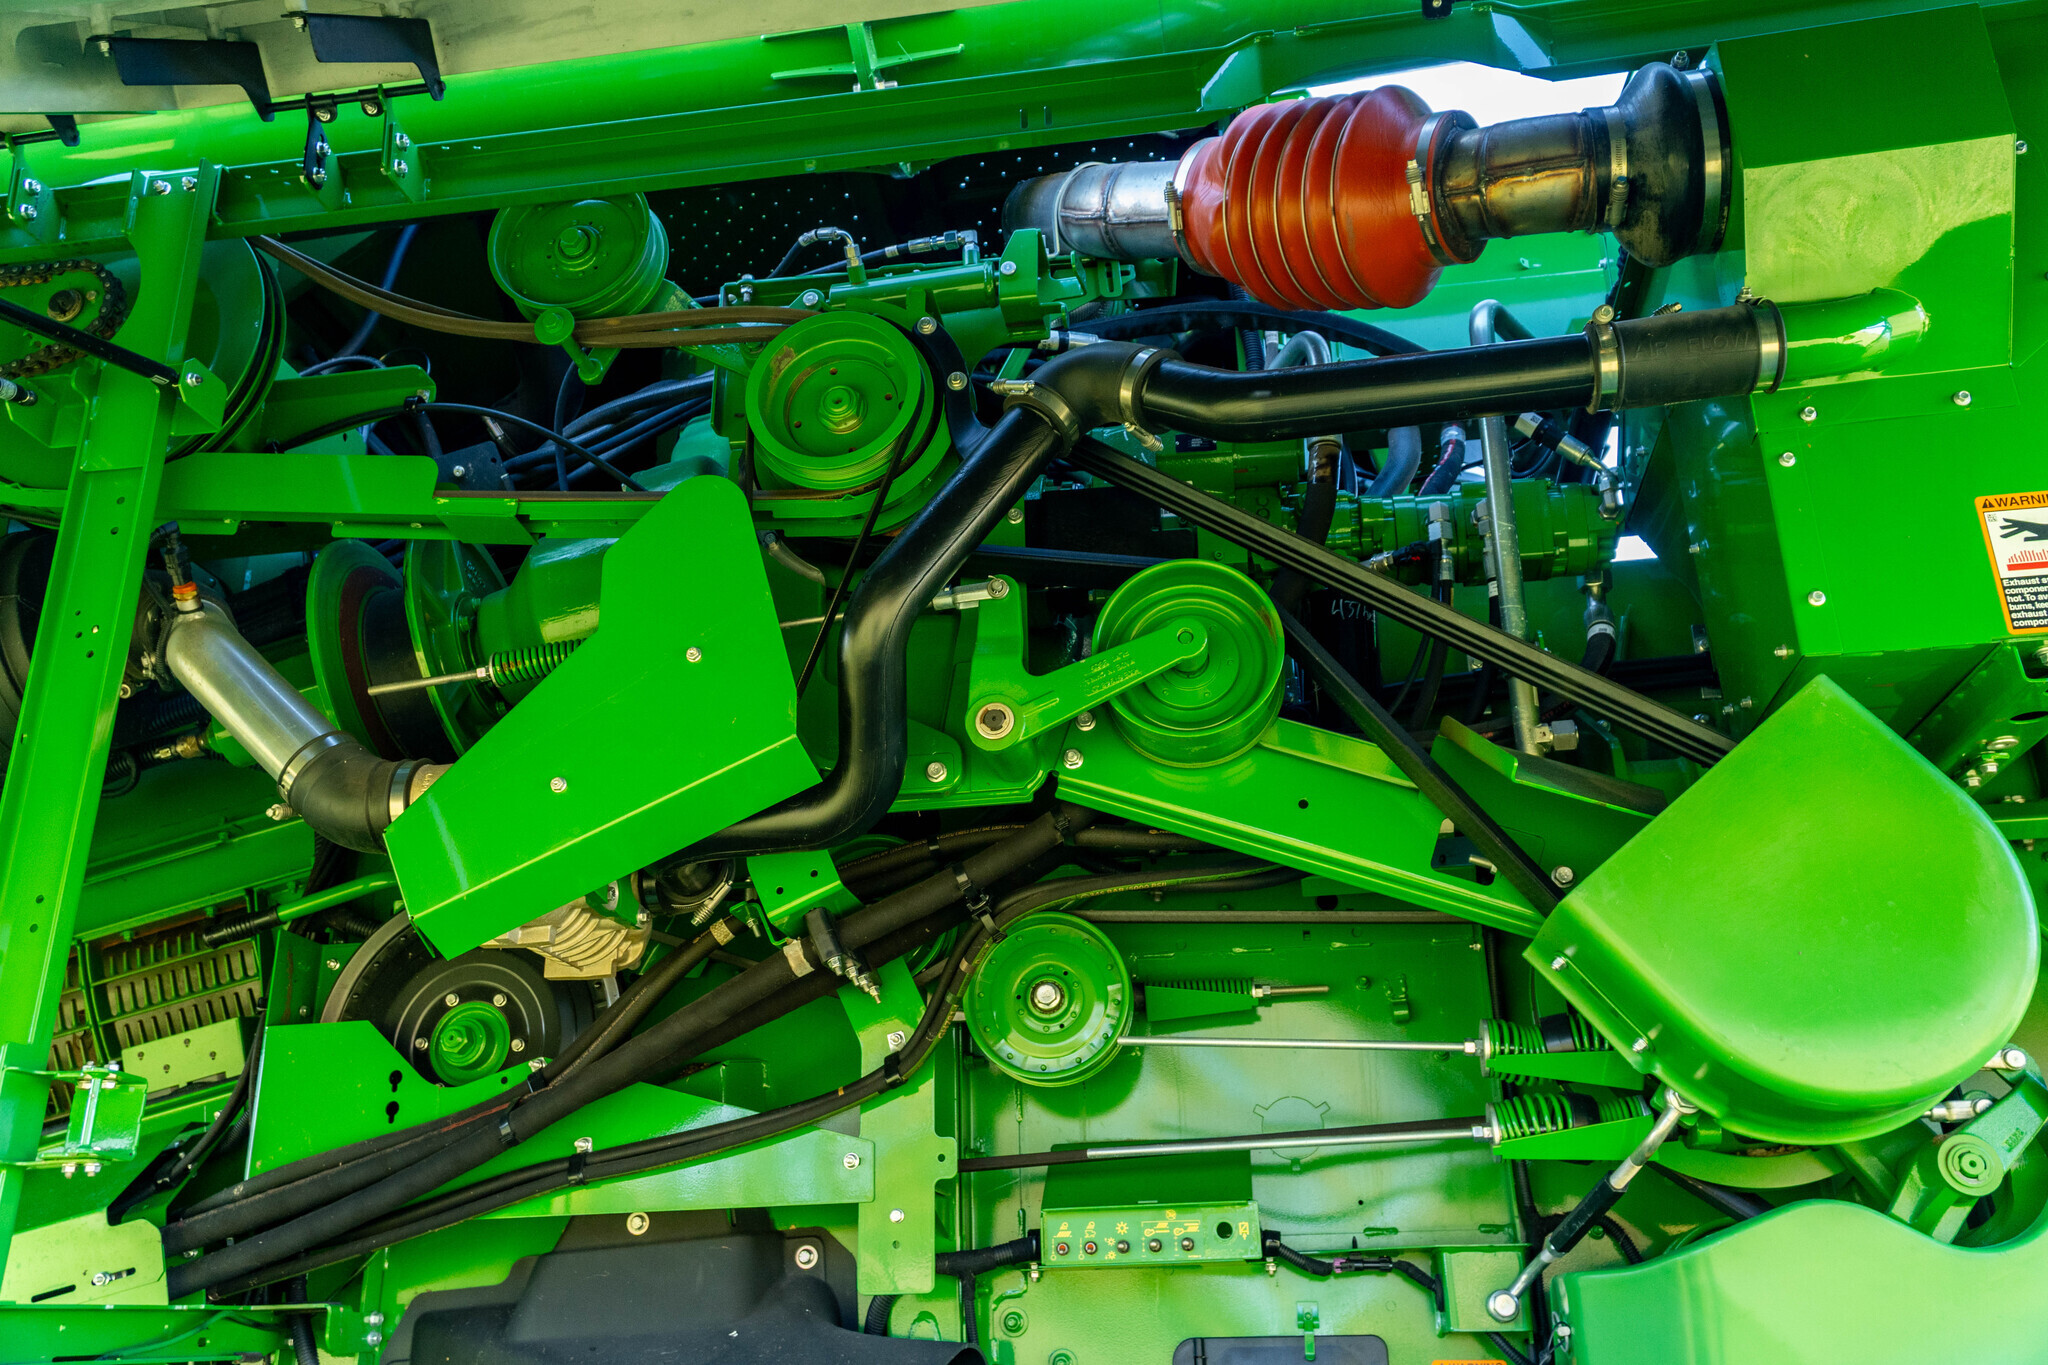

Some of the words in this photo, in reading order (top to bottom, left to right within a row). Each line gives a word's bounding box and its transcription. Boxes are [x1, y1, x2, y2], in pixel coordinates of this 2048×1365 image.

[1687, 330, 1756, 354] FLOW
[1995, 493, 2048, 508] WARNI
[2003, 577, 2040, 587] Exhaust
[2007, 594, 2025, 603] hot.
[2024, 593, 2036, 601] To
[2009, 602, 2036, 611] burns,
[2011, 609, 2047, 619] exhaust
